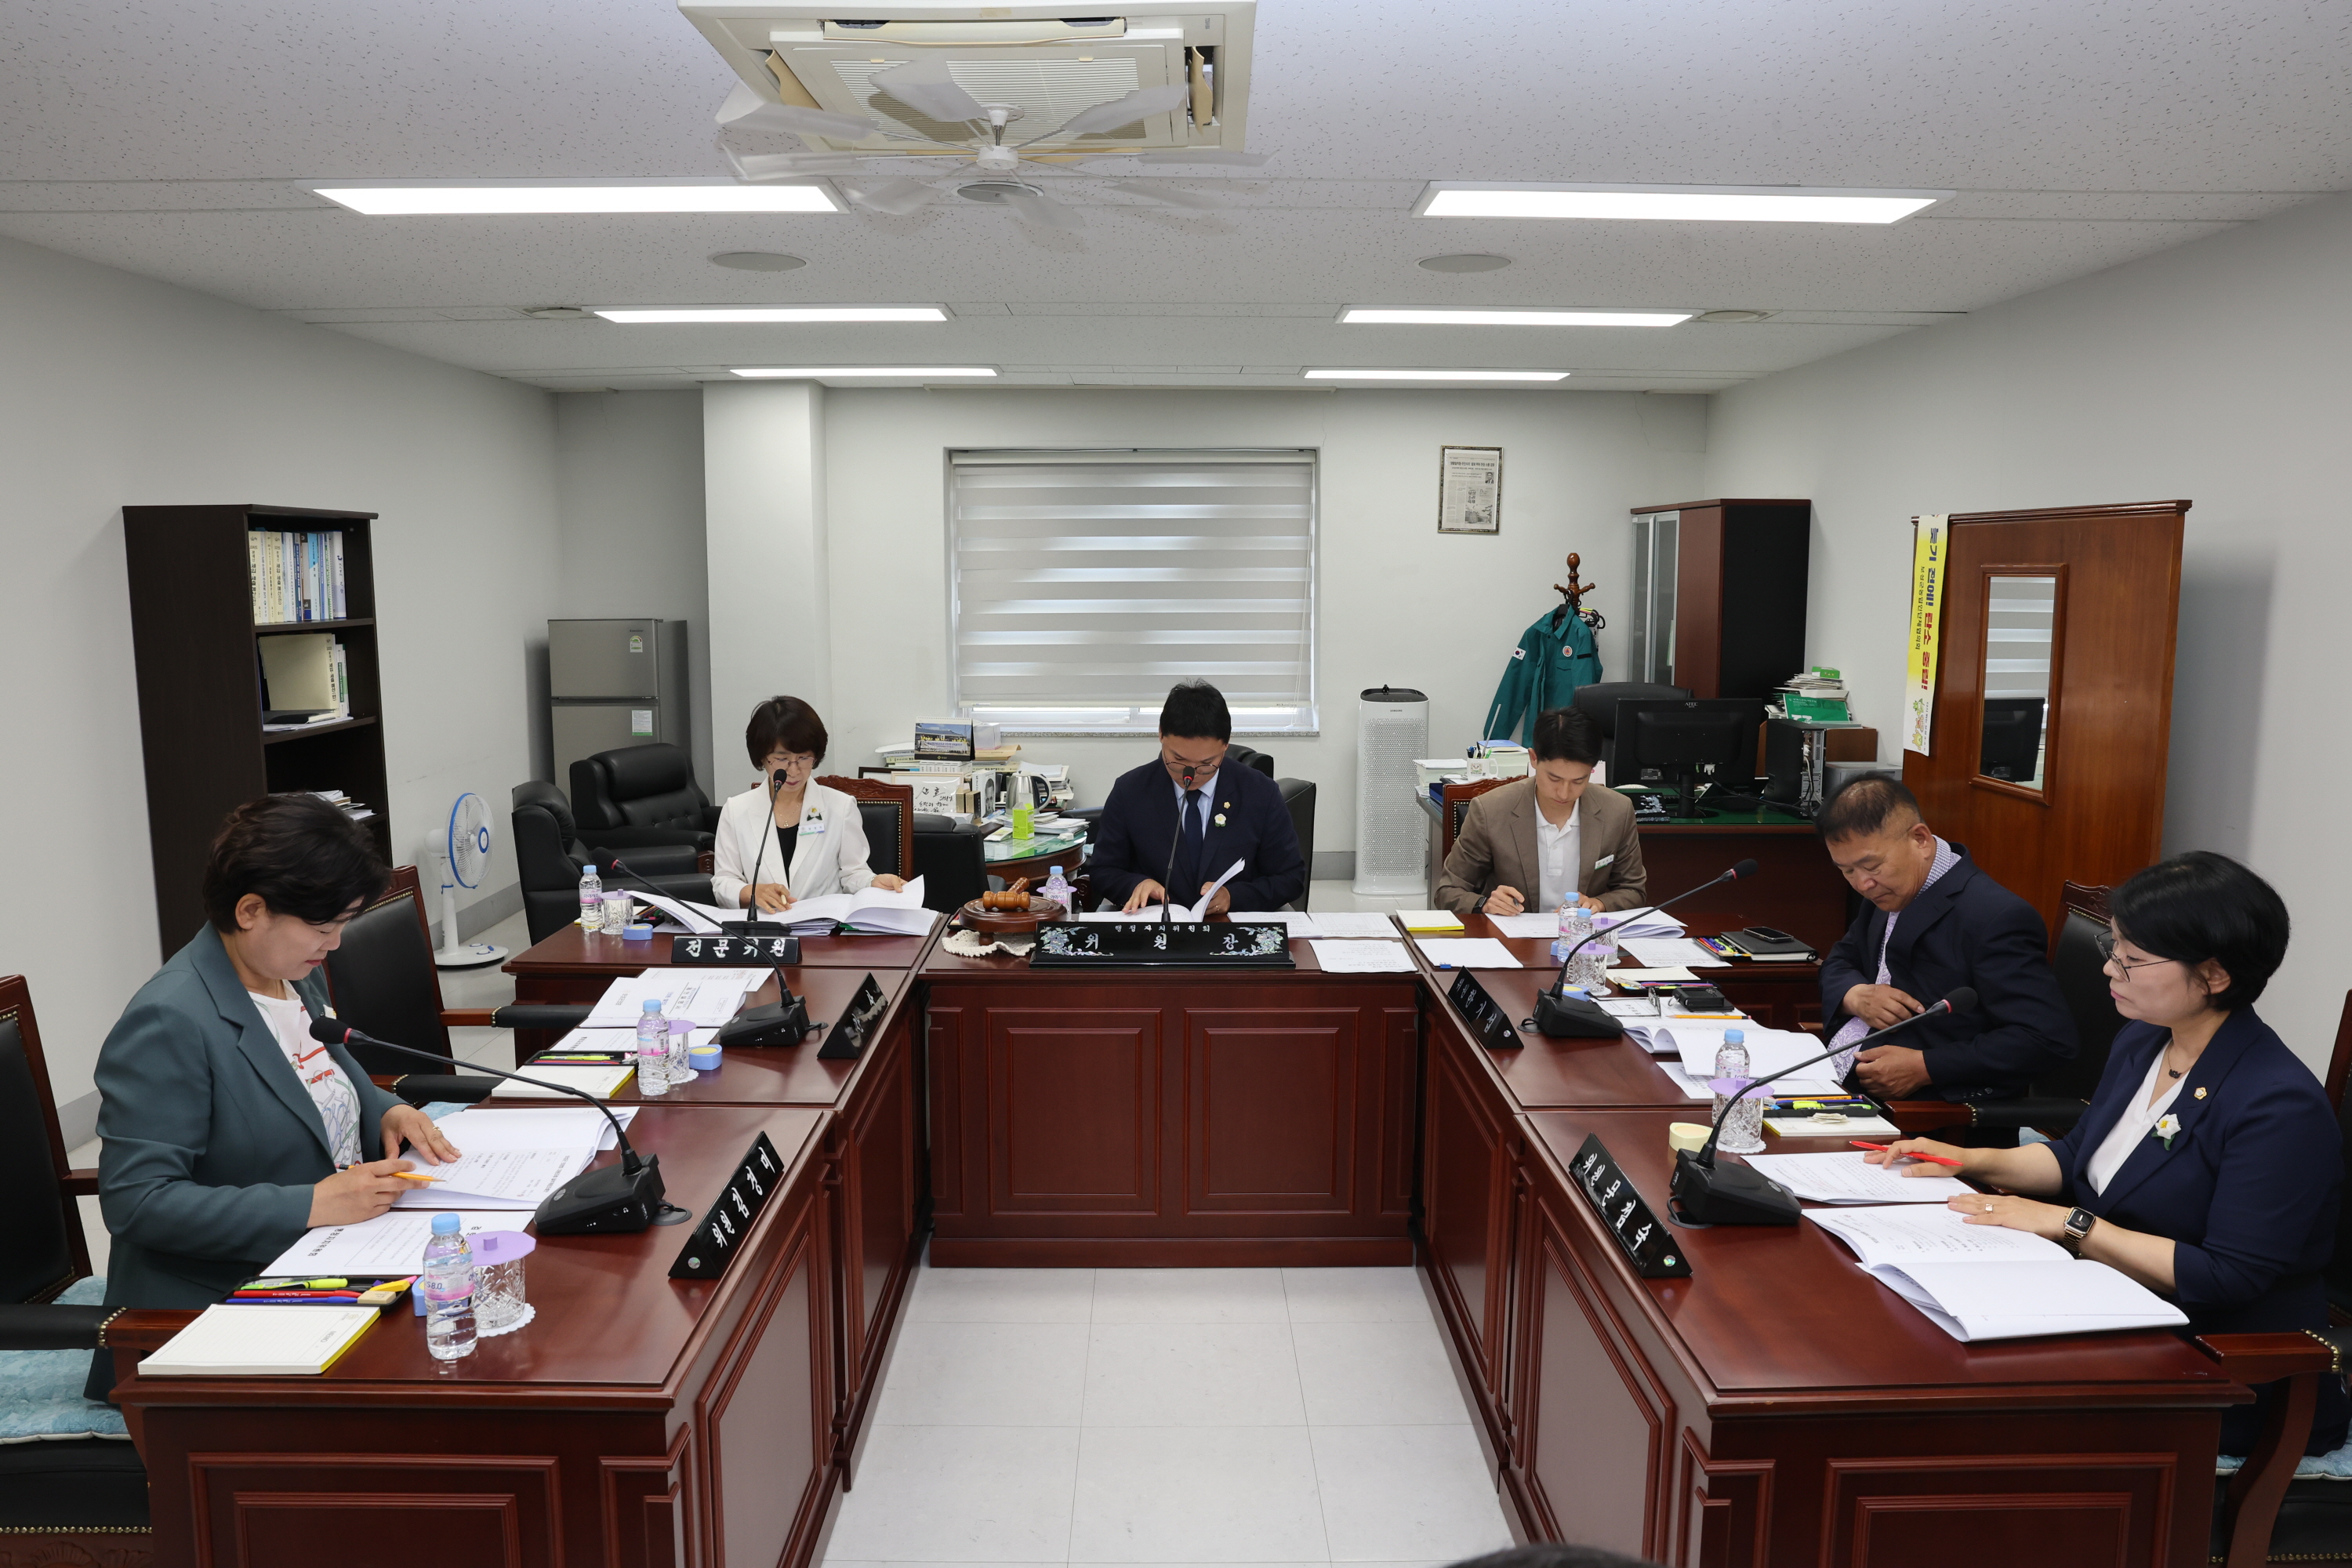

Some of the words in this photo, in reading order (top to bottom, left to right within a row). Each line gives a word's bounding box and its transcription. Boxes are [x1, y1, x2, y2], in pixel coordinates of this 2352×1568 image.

[1929, 528, 1939, 561] 늦기
[1926, 567, 1936, 607] 전에!
[1915, 566, 1926, 650] 보성군농업인단체협의회
[1923, 612, 1933, 645] 탄소
[1922, 652, 1930, 691] 중립!
[1084, 933, 1240, 950] 위원장
[1114, 924, 1210, 933] 행정자치위원회
[685, 938, 786, 958] 전문위원
[1583, 1152, 1606, 1188] 위원
[712, 1210, 735, 1249] 위원
